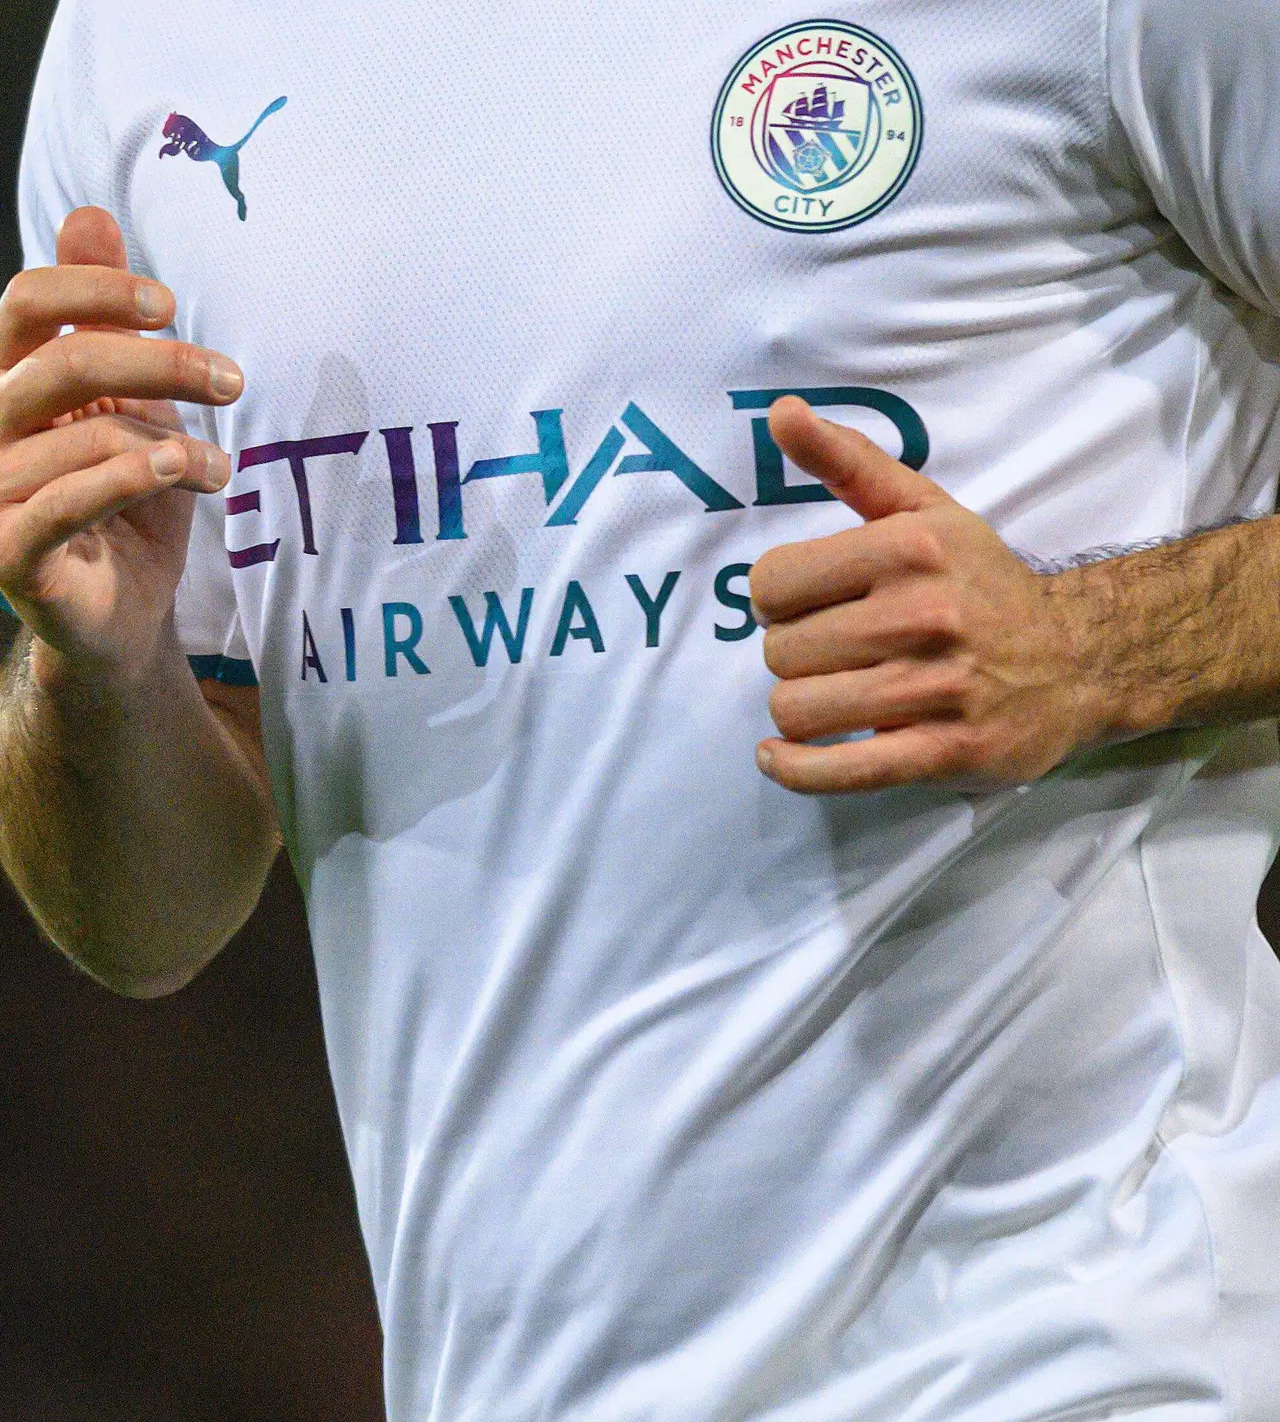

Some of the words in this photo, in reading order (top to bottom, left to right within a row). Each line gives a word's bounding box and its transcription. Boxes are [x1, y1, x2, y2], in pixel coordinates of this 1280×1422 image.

[741, 37, 902, 107] MANCHESTER
[729, 116, 744, 127] 18
[886, 129, 906, 141] 94
[774, 195, 834, 217] CITY
[225, 386, 930, 569] ETIHAD
[301, 562, 758, 684] AIRWAYS
